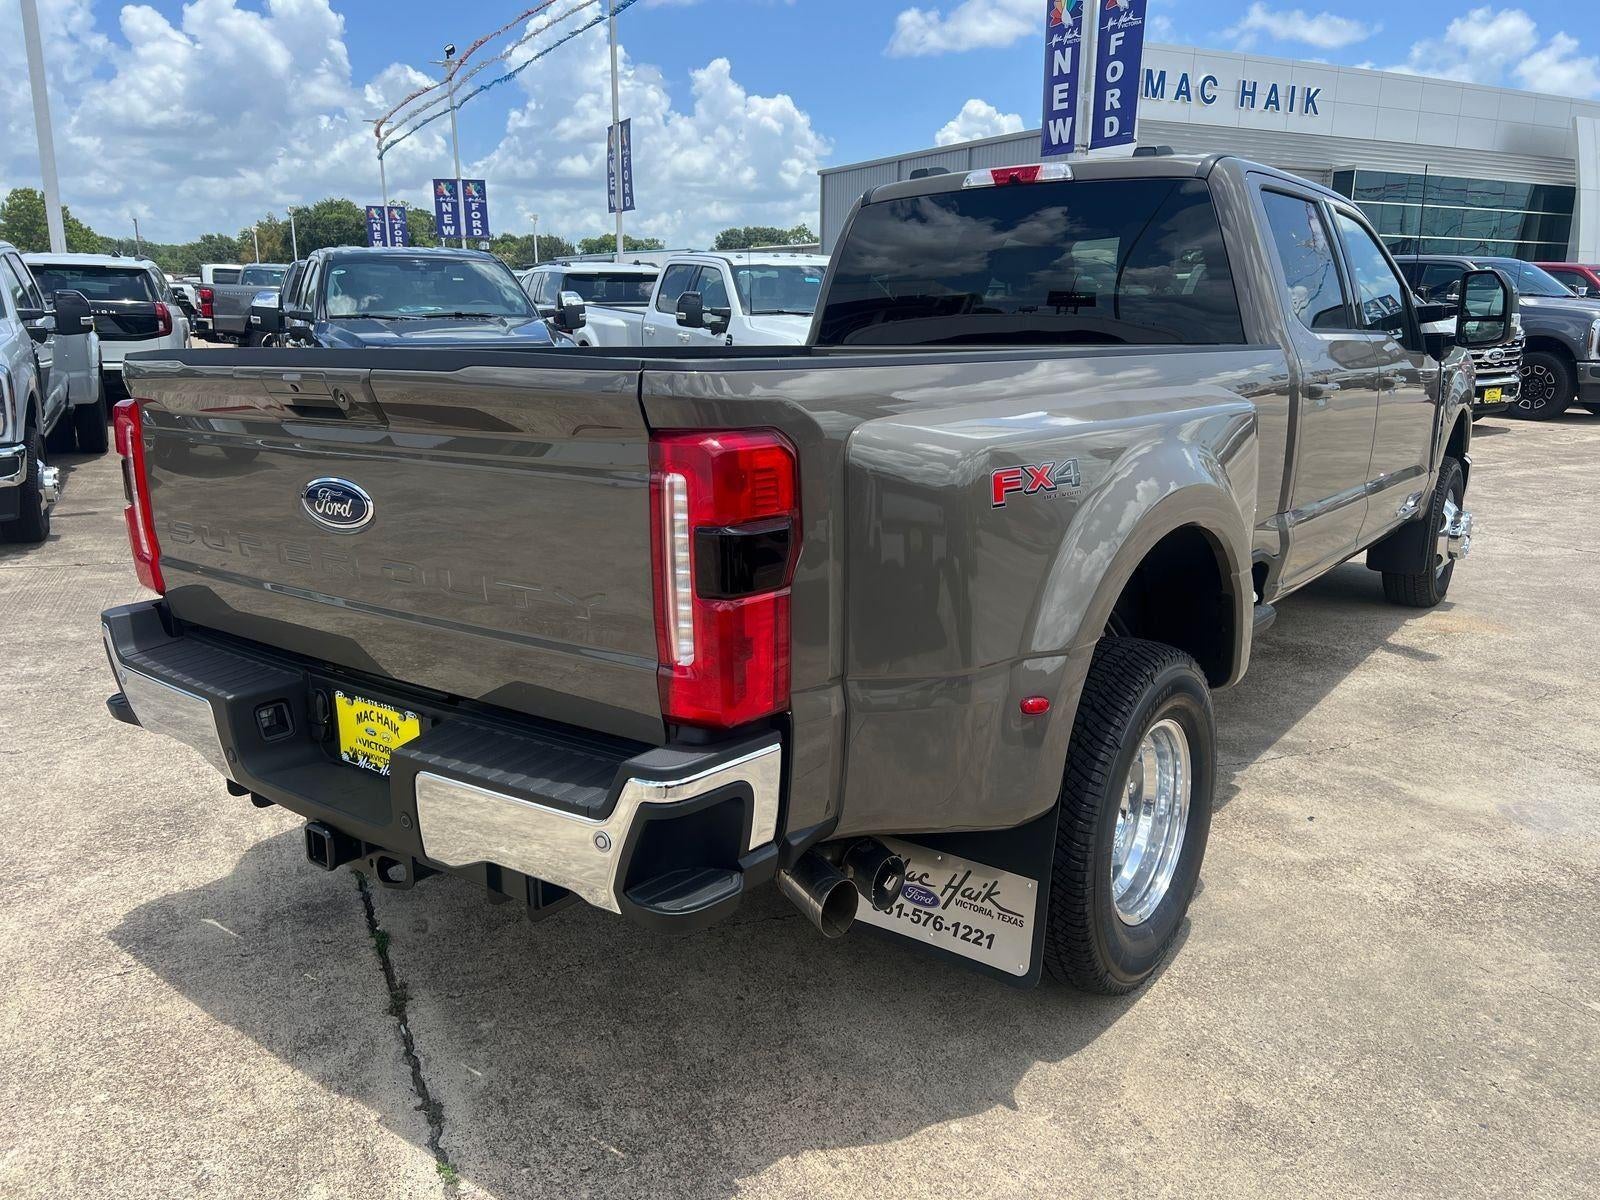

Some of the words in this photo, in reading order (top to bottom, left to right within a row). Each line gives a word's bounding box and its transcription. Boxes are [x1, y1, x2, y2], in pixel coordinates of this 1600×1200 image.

[1048, 47, 1072, 145] NEW
[1104, 31, 1124, 138] FORD
[1143, 67, 1219, 105] MAC
[1239, 79, 1322, 116] HAIK
[623, 157, 631, 206] FORD
[373, 223, 383, 247] NEW
[442, 202, 455, 235] NEW
[471, 202, 482, 236] FORD
[990, 458, 1081, 509] FX4
[314, 487, 353, 518] Ford
[168, 519, 360, 578] SUPER
[380, 557, 608, 620] DUTY
[356, 710, 374, 725] MAC
[377, 712, 400, 739] HAIK
[361, 738, 391, 755] VICTORI
[905, 886, 934, 905] Ford
[939, 869, 1025, 918] Haik
[954, 898, 994, 920] VICTORIA,
[997, 914, 1025, 928] TEXAS
